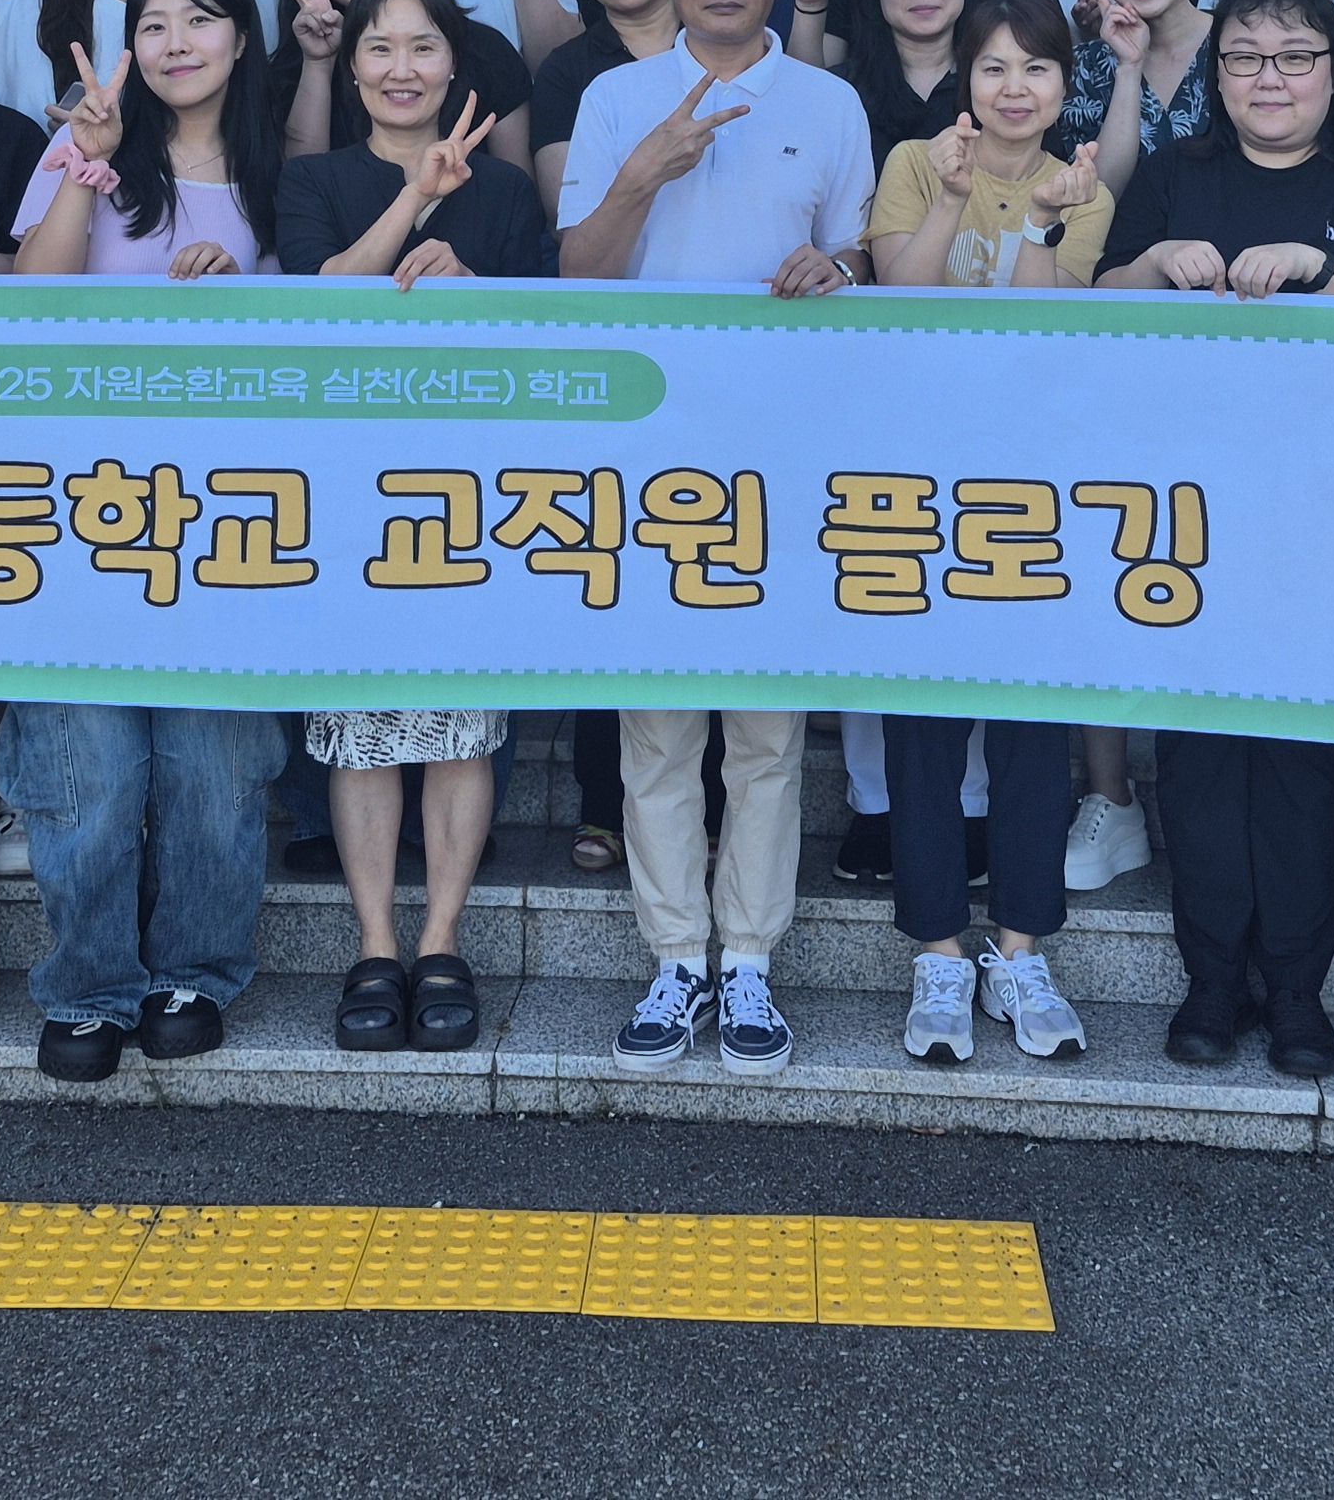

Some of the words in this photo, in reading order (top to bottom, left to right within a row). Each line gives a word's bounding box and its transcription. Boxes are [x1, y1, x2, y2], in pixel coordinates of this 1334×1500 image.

[64, 366, 309, 403] 자원순환교육
[321, 367, 517, 405] 실천(선도)
[527, 368, 610, 405] 학교
[363, 467, 769, 610] 교직원
[817, 472, 1209, 628] 플로깅
